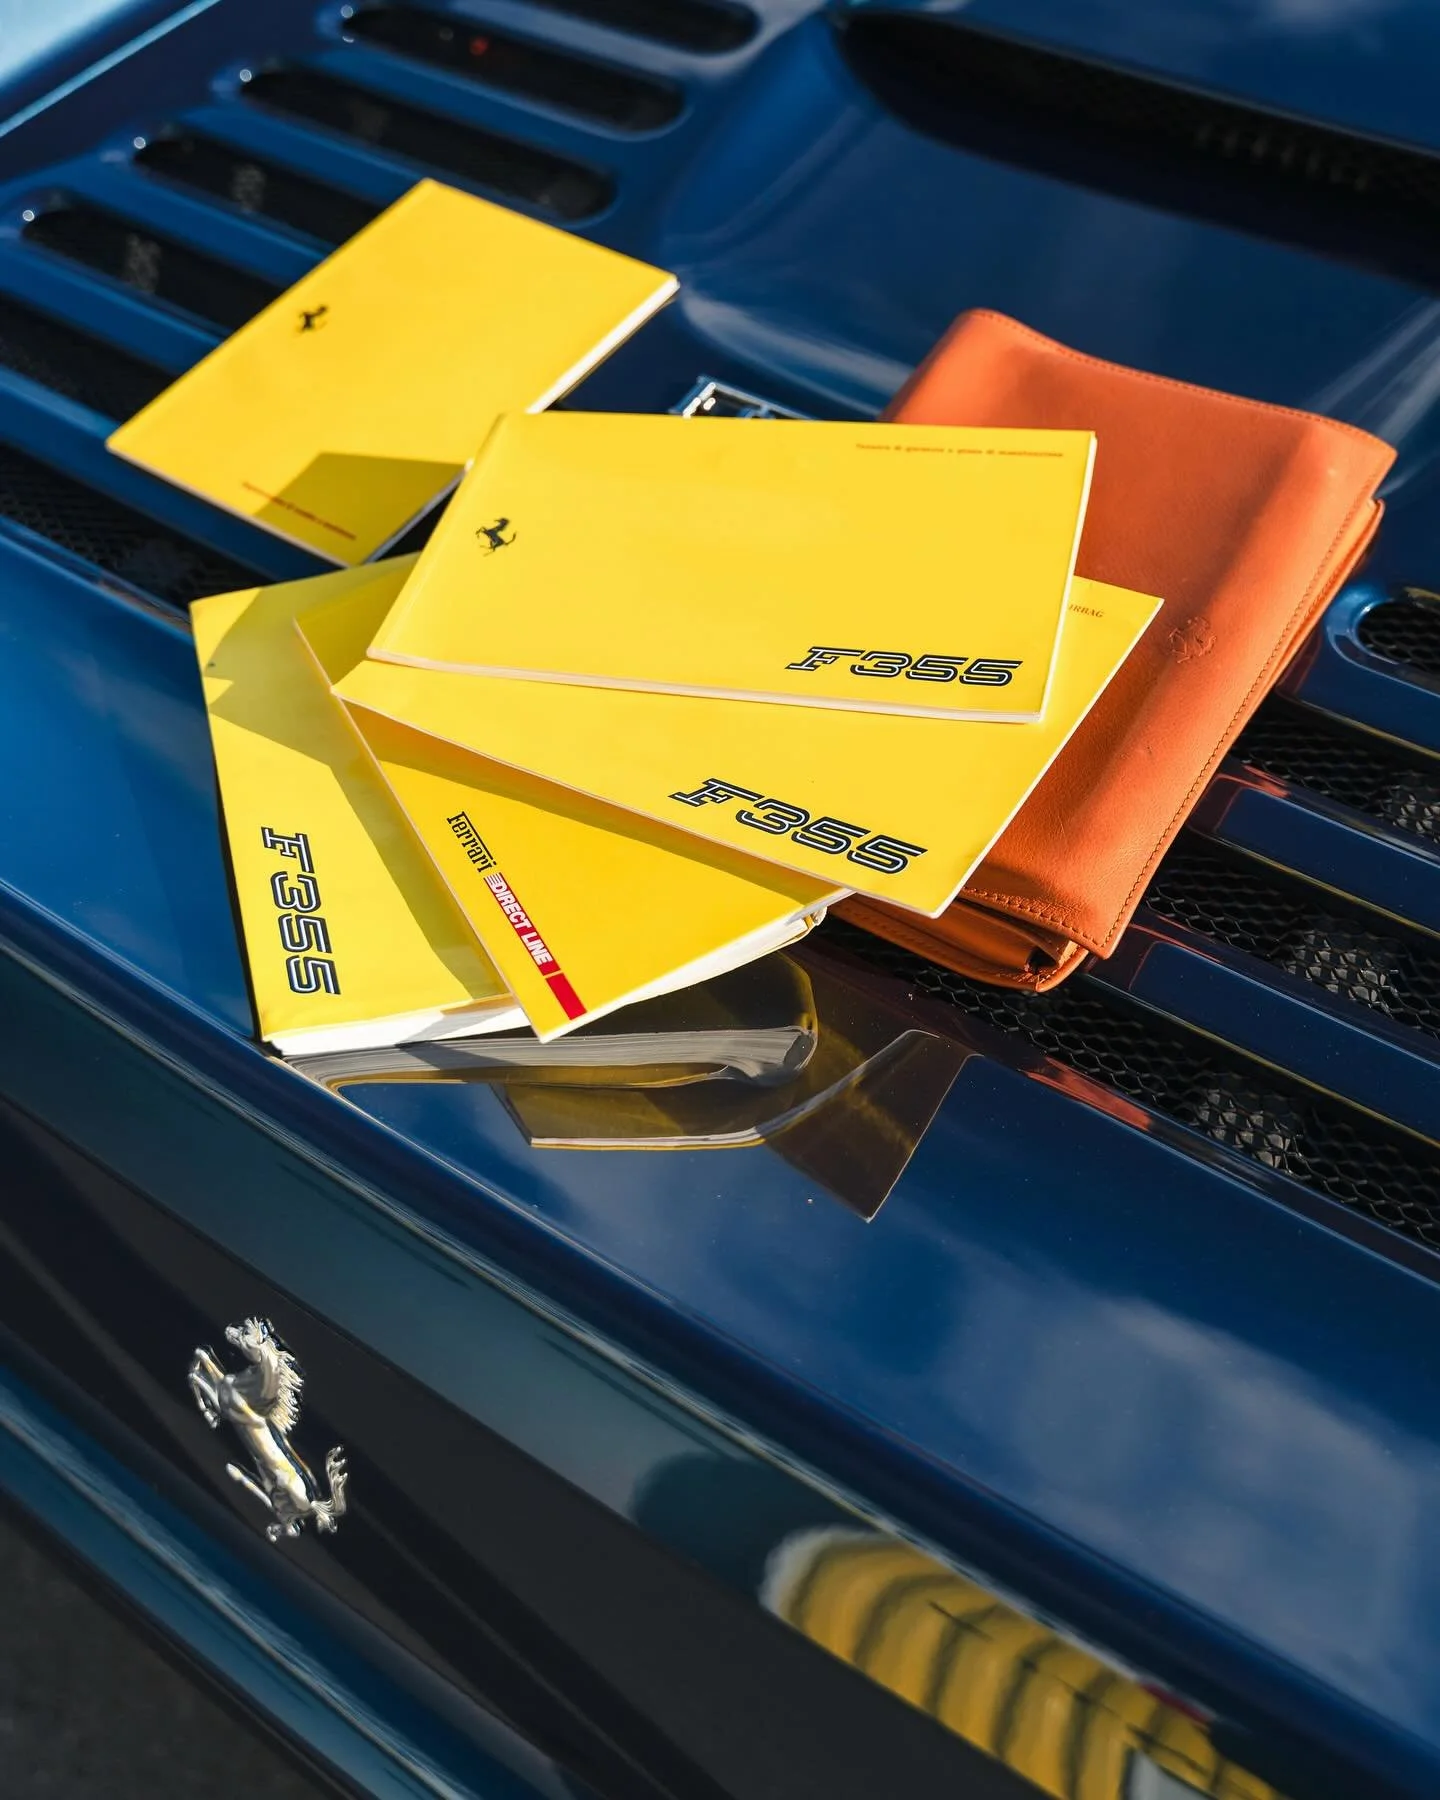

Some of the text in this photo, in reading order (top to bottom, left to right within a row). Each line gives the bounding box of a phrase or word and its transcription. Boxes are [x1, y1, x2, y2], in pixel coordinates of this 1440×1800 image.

[1068, 603, 1104, 618] IRBAG
[785, 645, 1024, 687] F355
[668, 777, 929, 875] F355
[260, 826, 341, 995] F355
[446, 811, 554, 966] Ferrari DIRECT LINE
